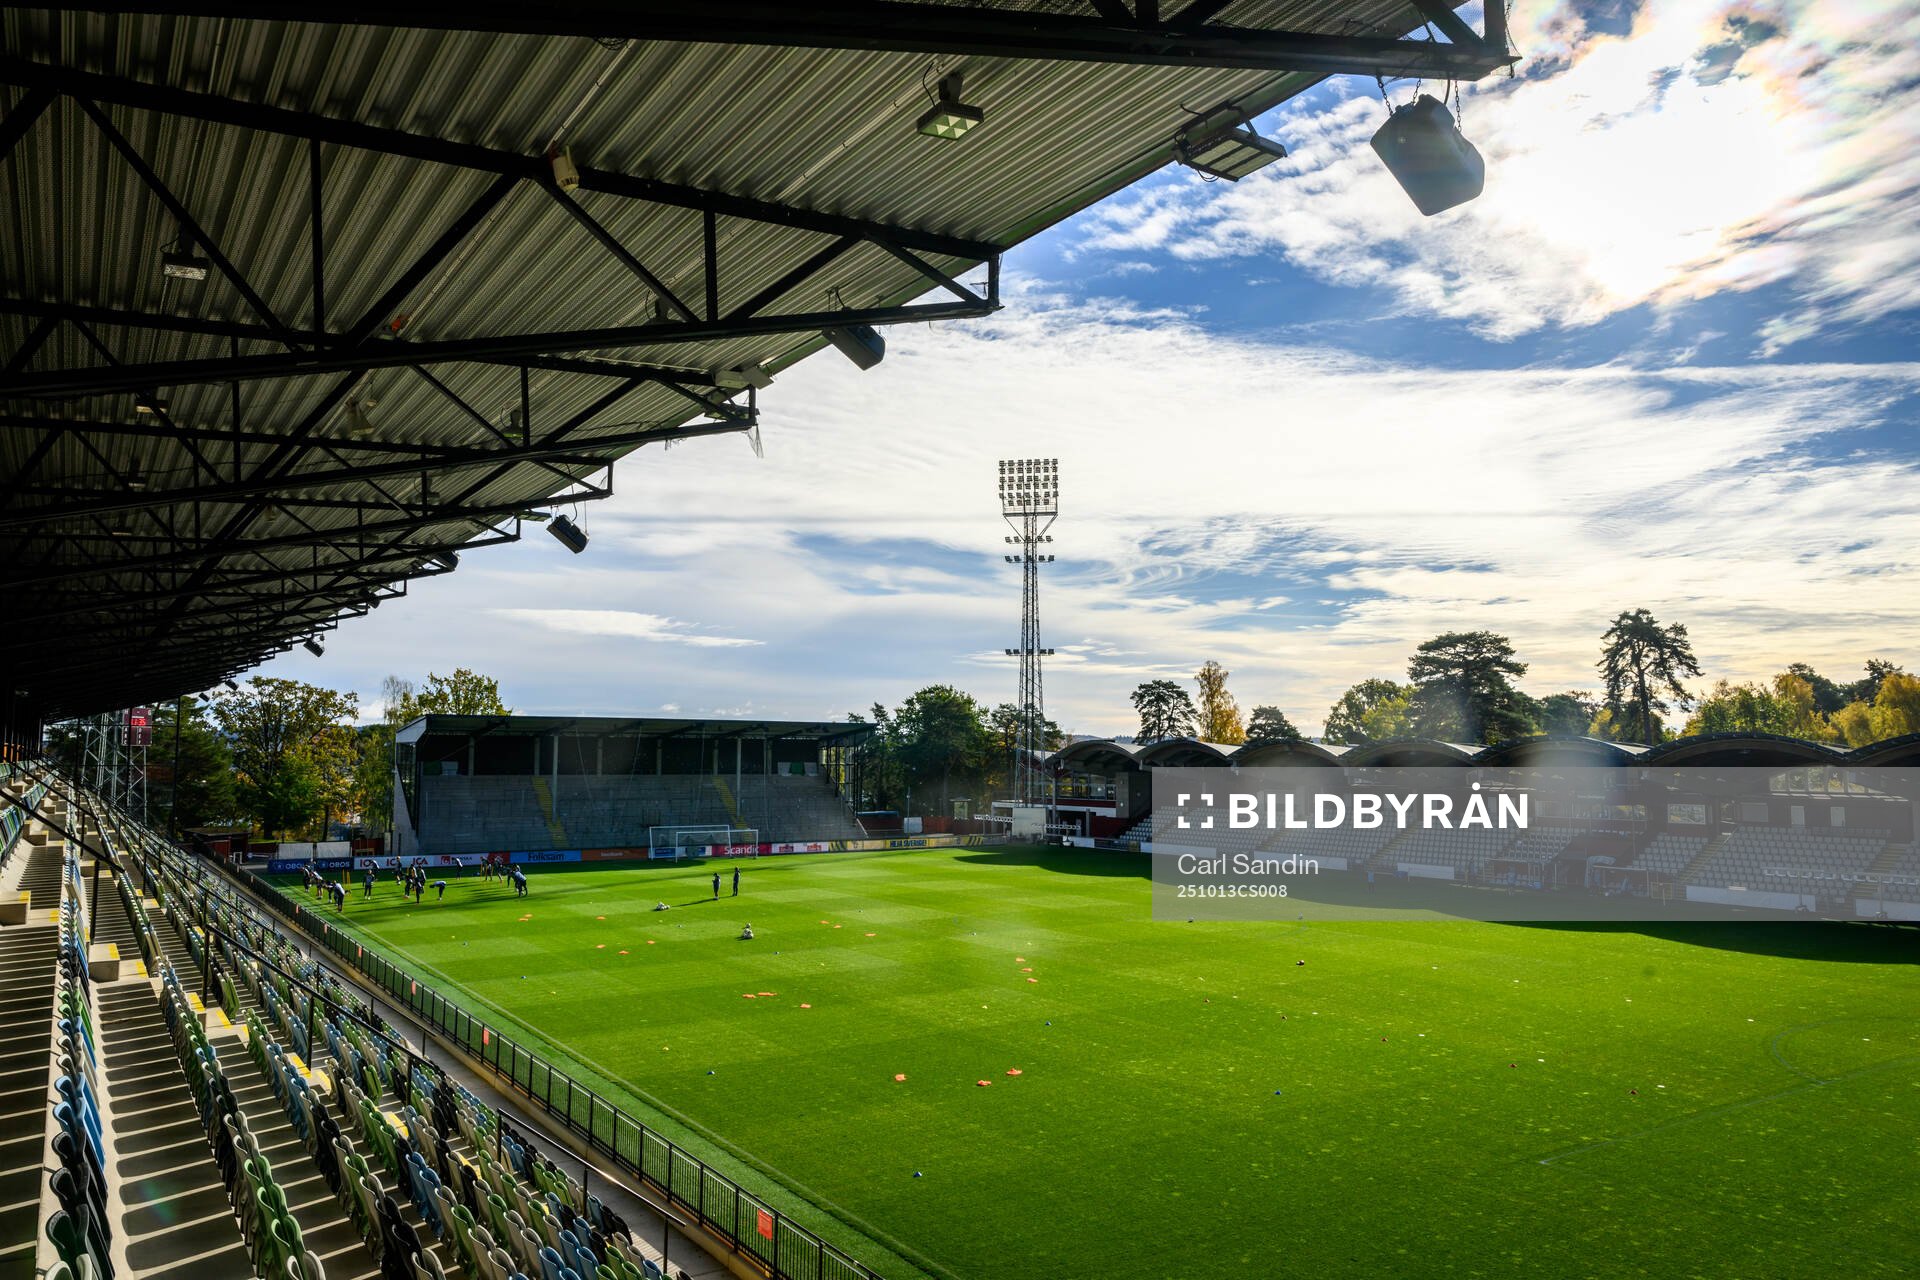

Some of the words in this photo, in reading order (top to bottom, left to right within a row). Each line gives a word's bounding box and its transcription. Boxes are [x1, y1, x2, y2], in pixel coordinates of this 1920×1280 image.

[724, 845, 760, 855] Scandic
[528, 850, 564, 861] Folksam
[412, 857, 429, 866] ICA
